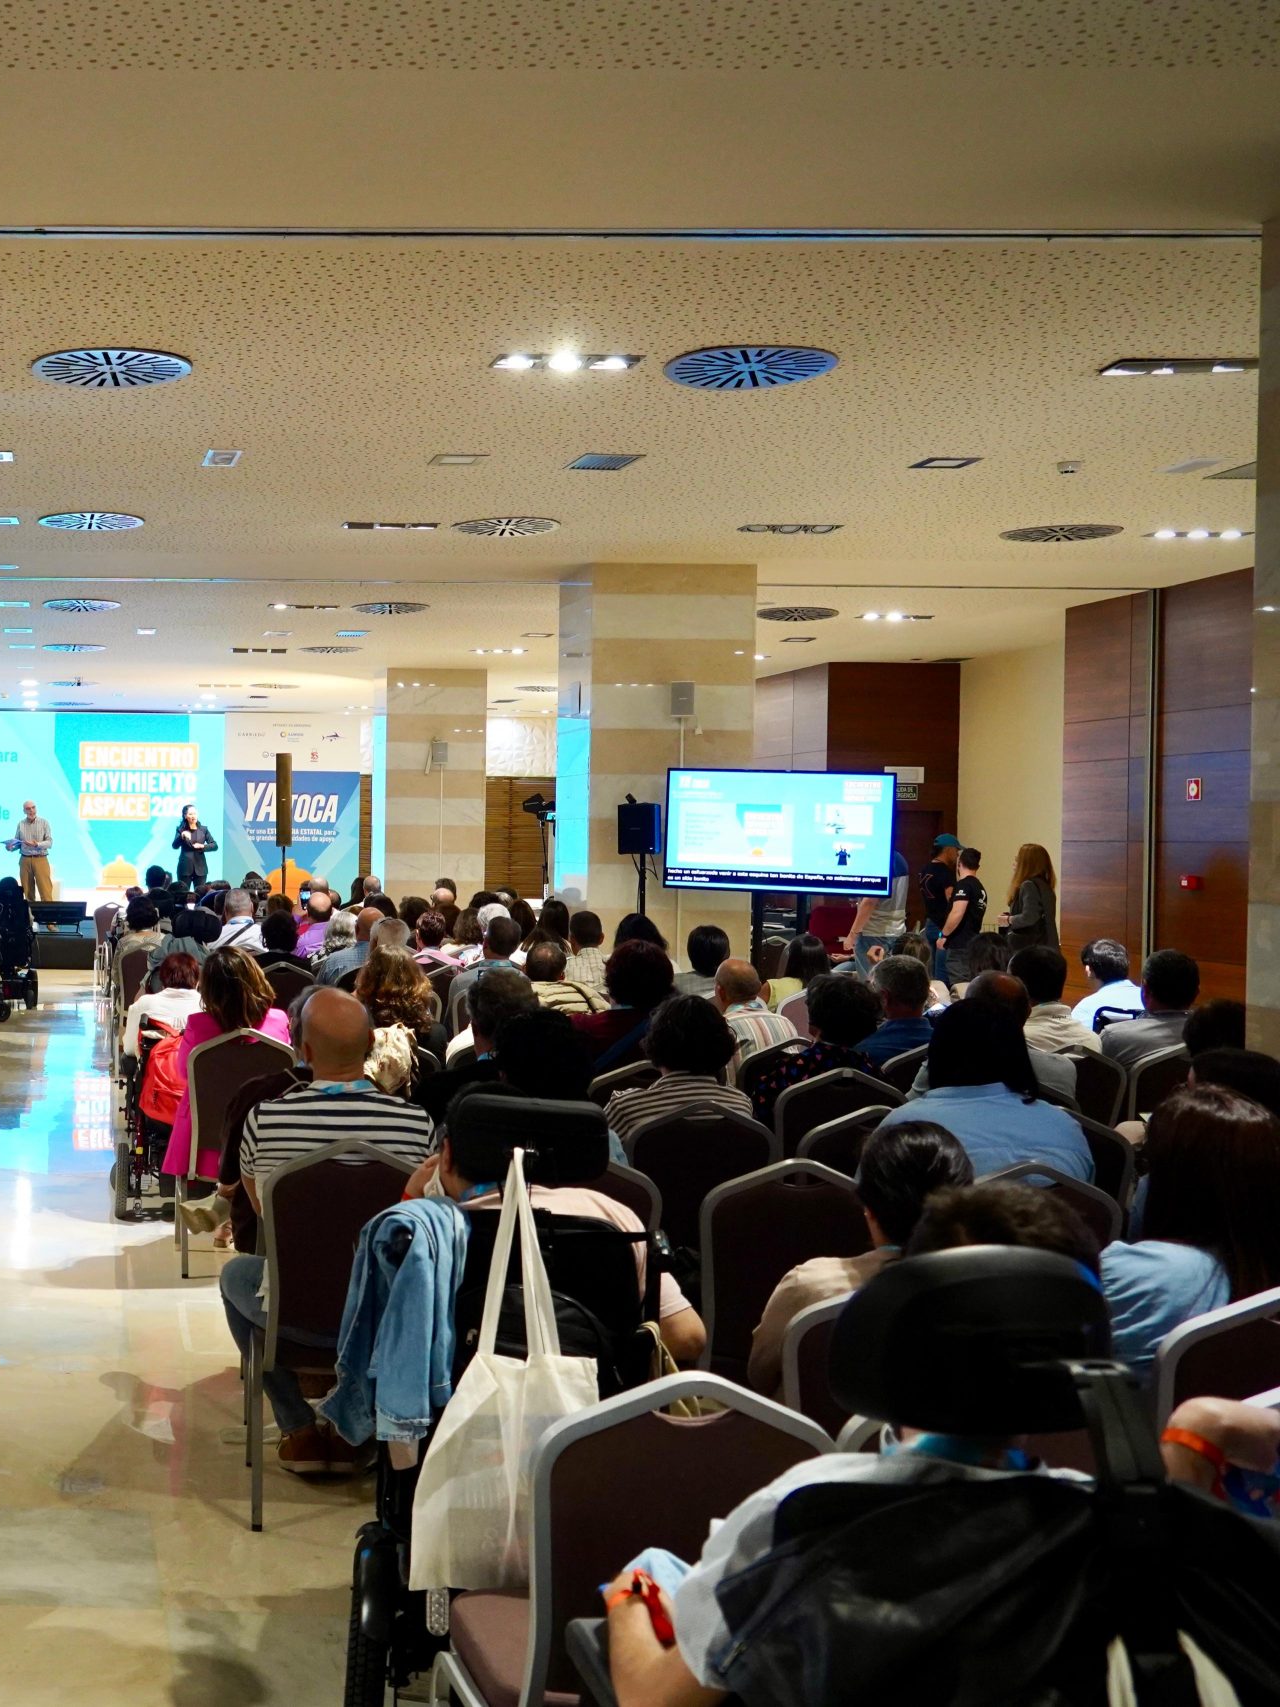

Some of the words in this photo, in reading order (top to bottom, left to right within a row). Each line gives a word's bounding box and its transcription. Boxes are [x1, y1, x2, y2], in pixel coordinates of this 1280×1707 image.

[85, 746, 193, 767] ENCUENTRO
[82, 771, 196, 792] MOVIMIENTO
[82, 797, 147, 817] ASPACE
